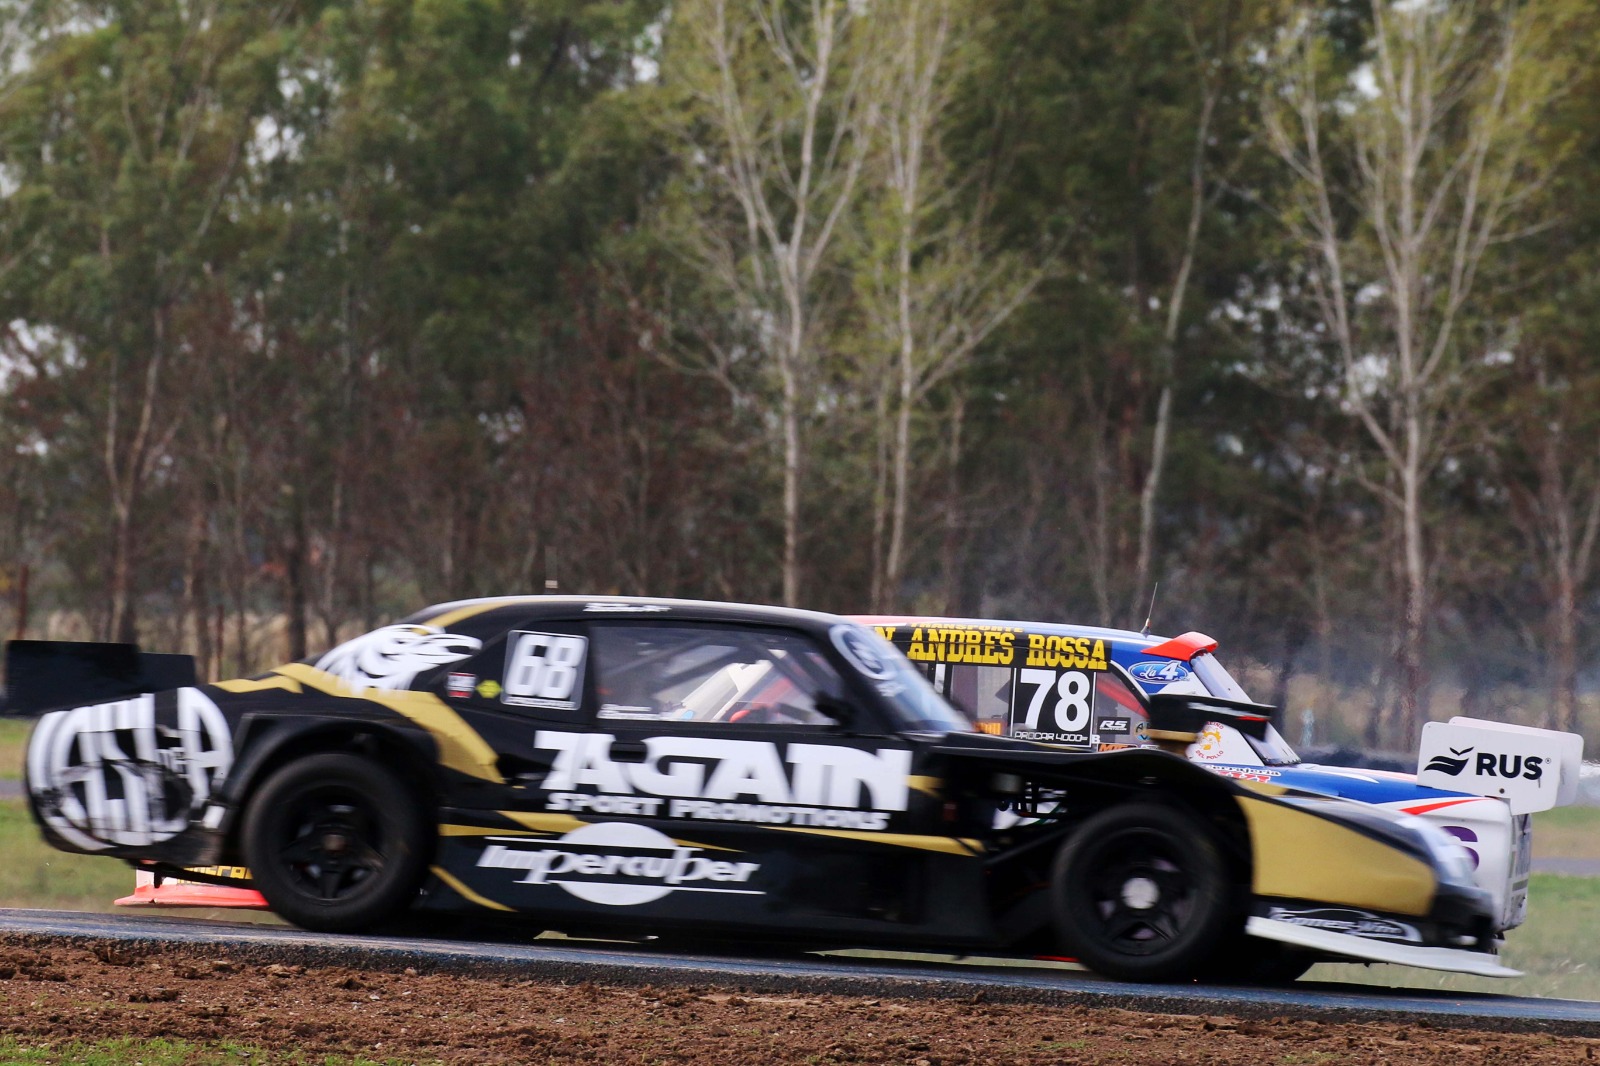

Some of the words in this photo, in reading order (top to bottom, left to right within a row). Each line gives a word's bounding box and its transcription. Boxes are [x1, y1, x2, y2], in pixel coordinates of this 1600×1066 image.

[907, 627, 1015, 665] ANDRES
[1026, 633, 1108, 670] ROSSA
[505, 633, 585, 699] 68
[1158, 662, 1180, 681] 4
[1020, 669, 1090, 732] 78
[1015, 731, 1055, 741] PROCAR
[1100, 720, 1128, 730] RS
[1476, 752, 1544, 781] RUS
[545, 793, 665, 816] SPORT
[669, 800, 891, 831] PROMOTIONS
